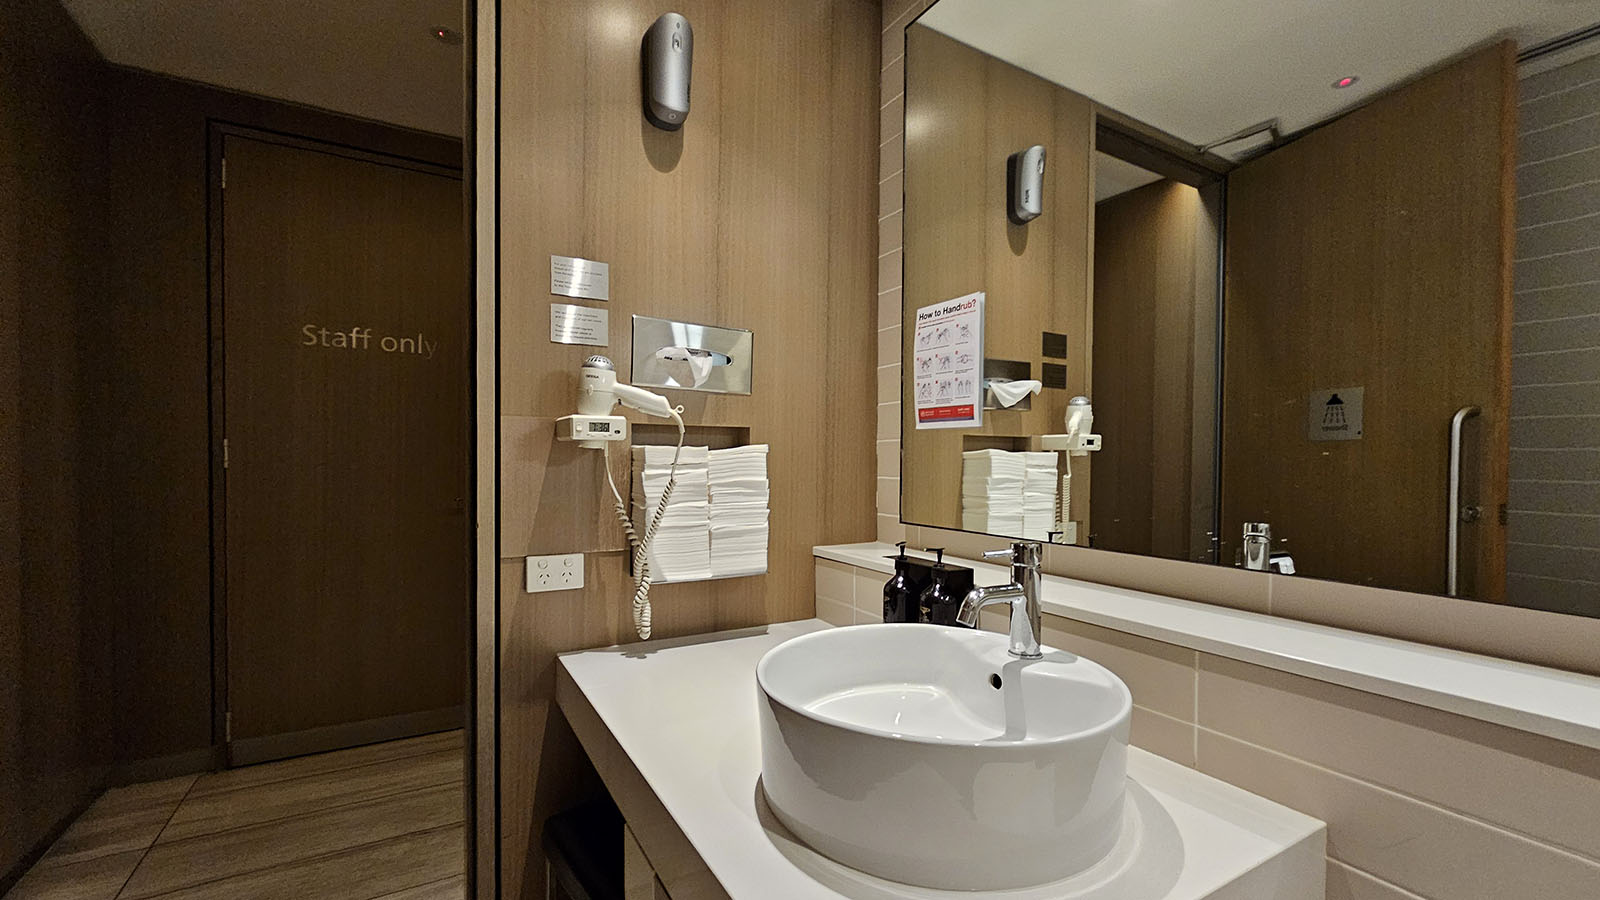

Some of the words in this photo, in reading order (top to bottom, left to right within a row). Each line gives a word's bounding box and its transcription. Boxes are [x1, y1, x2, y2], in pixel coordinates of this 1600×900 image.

[919, 312, 933, 321] How
[934, 309, 942, 317] to
[943, 298, 977, 315] Handrub?
[302, 324, 372, 350] Staff
[380, 332, 438, 360] only
